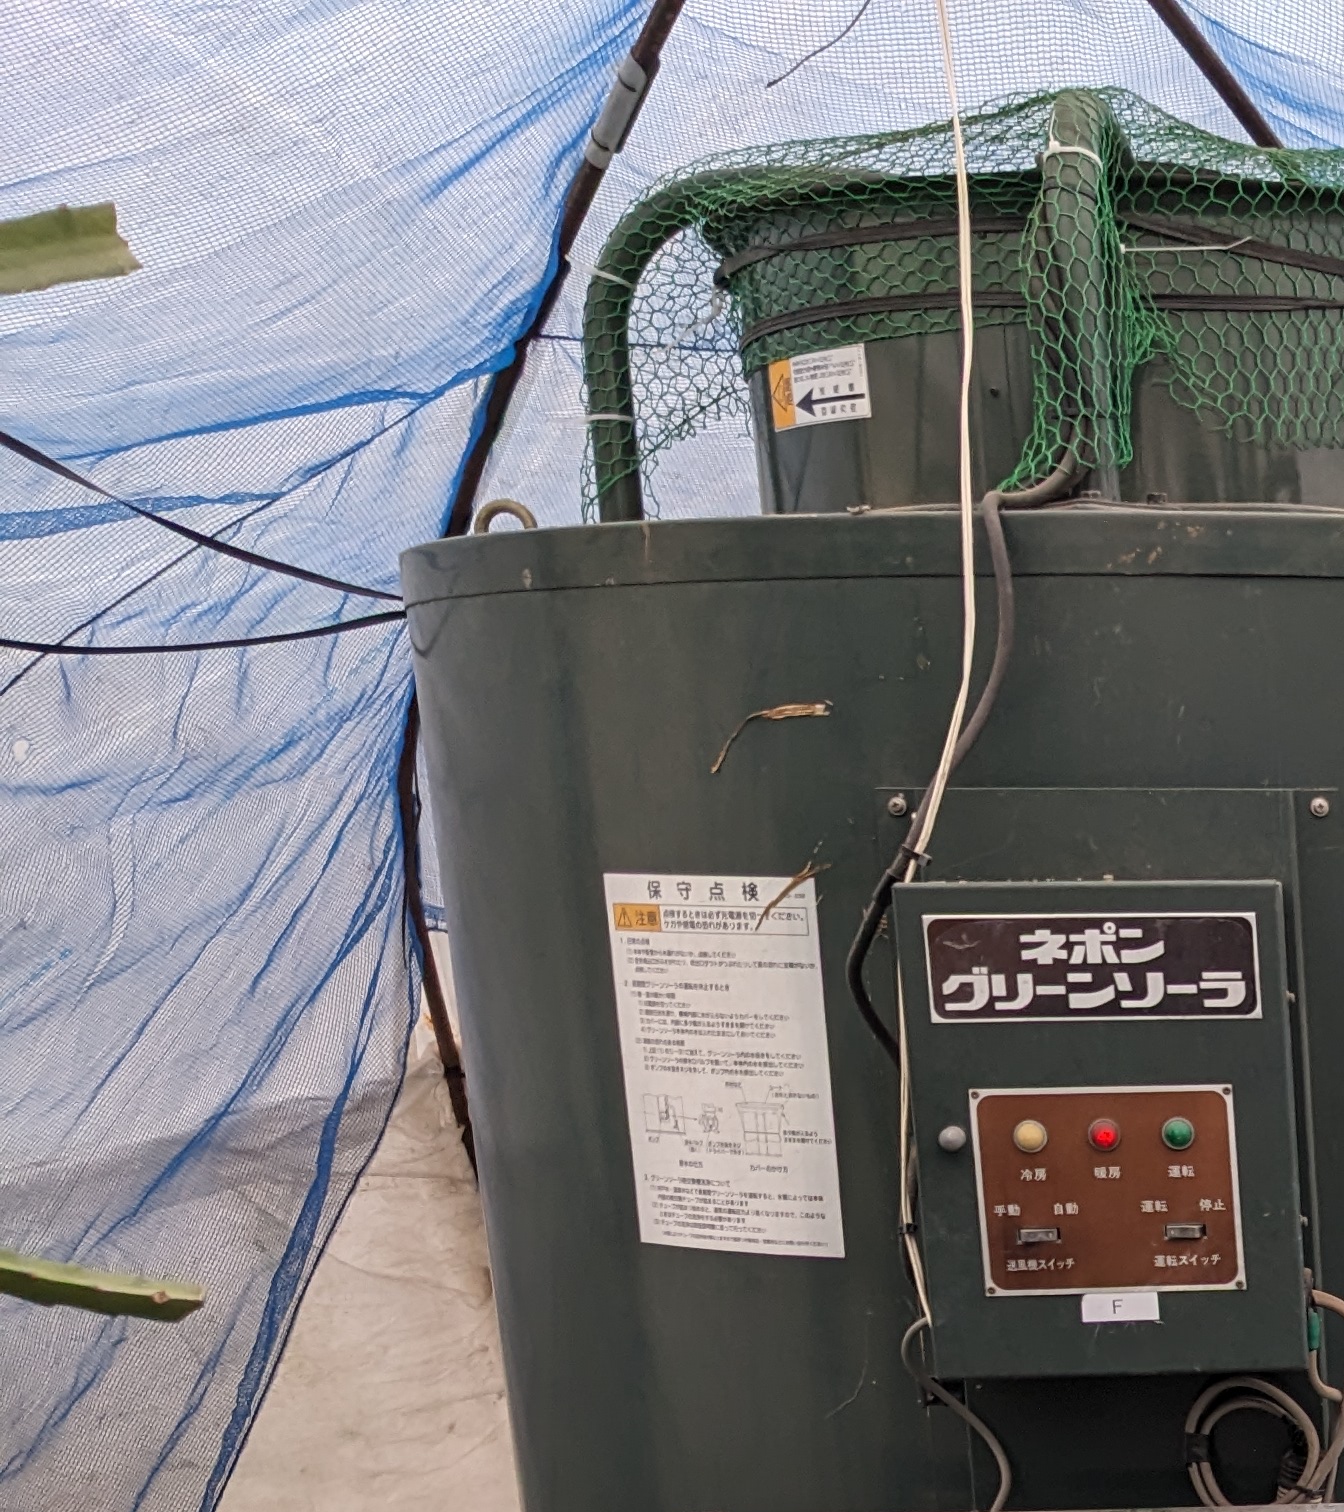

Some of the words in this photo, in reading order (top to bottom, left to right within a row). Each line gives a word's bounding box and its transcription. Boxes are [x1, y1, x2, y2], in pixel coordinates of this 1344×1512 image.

[646, 880, 760, 902] 保守点検
[635, 909, 658, 926] 注意
[1019, 921, 1165, 965] ネポン
[941, 966, 1247, 1012] グリーンソーラ
[1020, 1168, 1047, 1182] 冷房
[1094, 1166, 1121, 1179] 暖房
[1168, 1165, 1195, 1178] 運転
[994, 1204, 1021, 1217] 手動
[1053, 1202, 1079, 1215] 自動
[1140, 1200, 1168, 1213] 運転
[1199, 1198, 1227, 1212] 停止
[1007, 1258, 1075, 1272] 送風機スイッチ
[1154, 1254, 1222, 1267] 運転スイッチ
[1112, 1298, 1124, 1315] F
